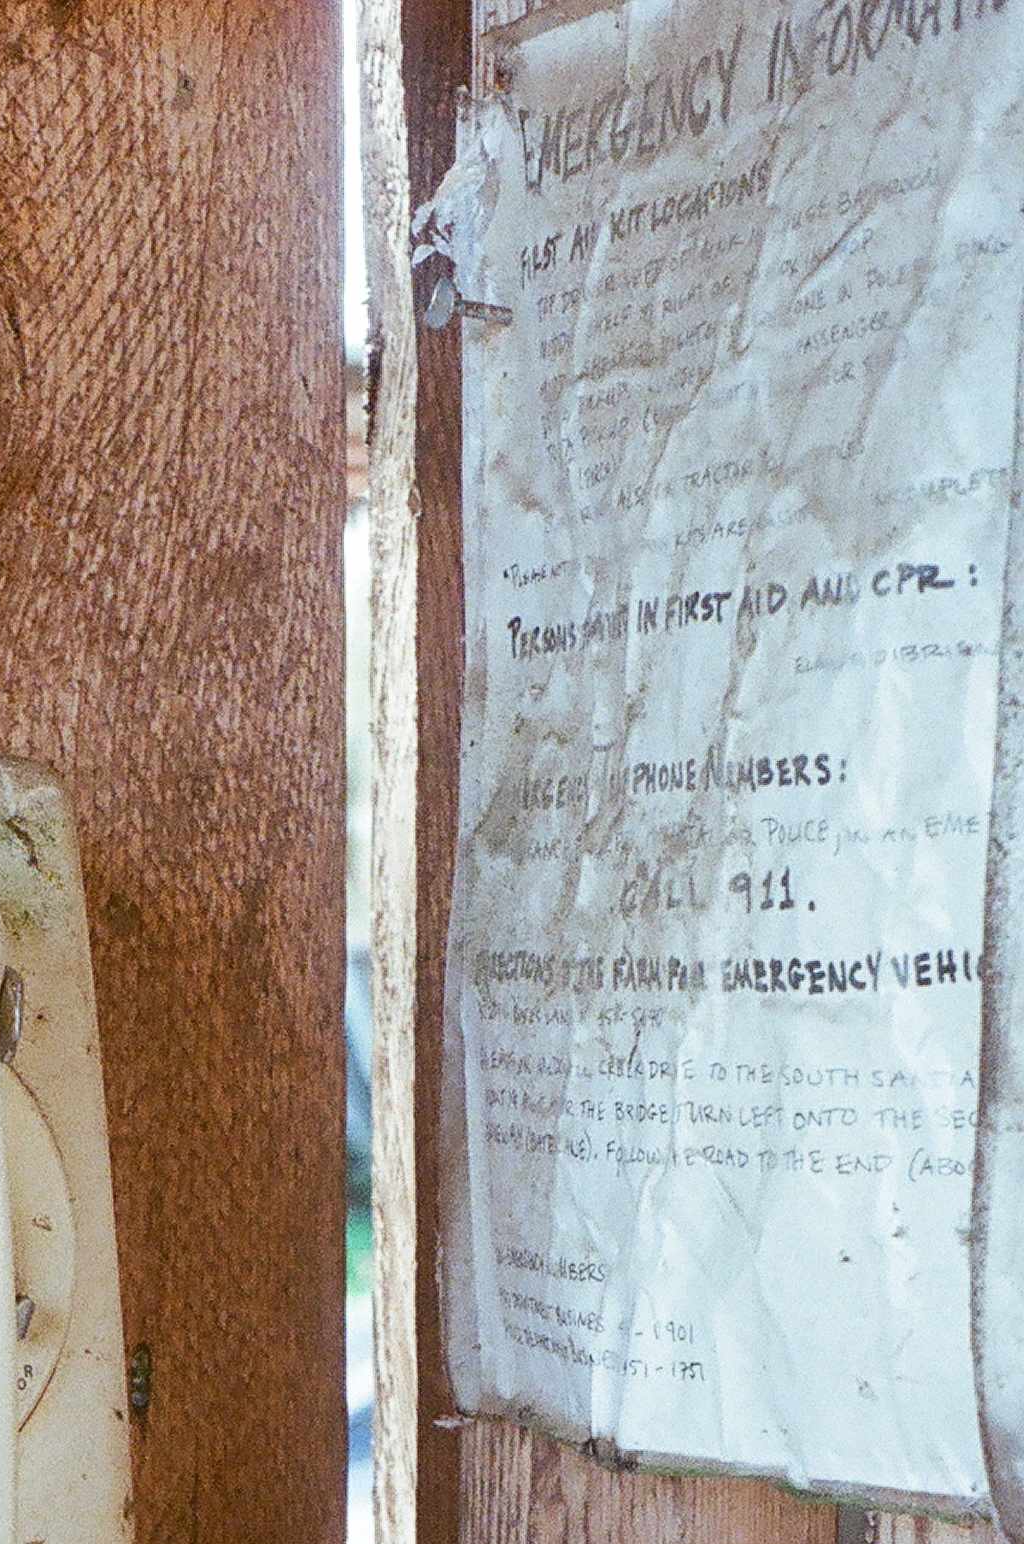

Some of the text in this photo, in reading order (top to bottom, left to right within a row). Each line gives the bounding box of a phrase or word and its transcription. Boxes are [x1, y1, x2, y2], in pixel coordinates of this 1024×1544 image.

[664, 590, 732, 634] FIRST
[729, 866, 816, 914] 911.
[722, 950, 882, 995] EMERGENCY
[792, 1107, 858, 1131] ONTO
